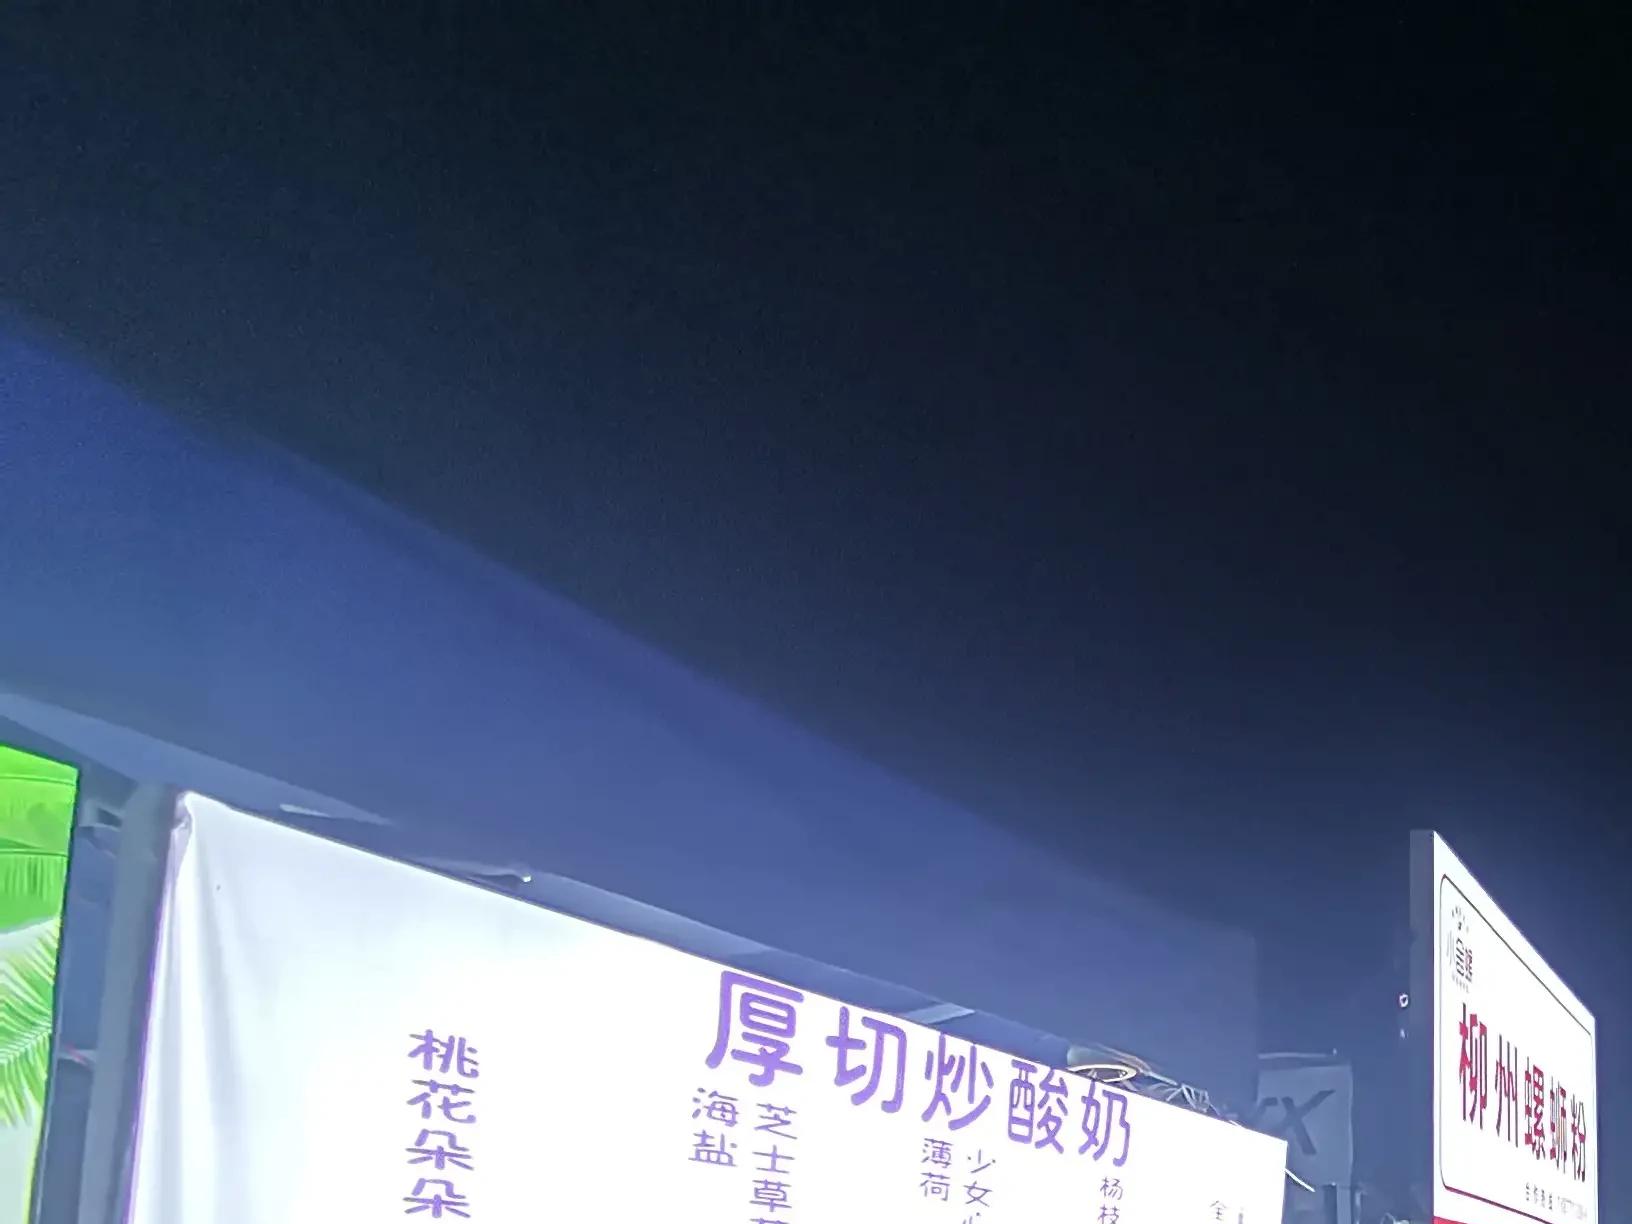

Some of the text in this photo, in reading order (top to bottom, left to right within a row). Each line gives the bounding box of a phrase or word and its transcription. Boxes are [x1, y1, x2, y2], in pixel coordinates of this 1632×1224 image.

[403, 1029, 480, 1220] 桃花朵朵
[688, 1087, 740, 1167] 海盐
[705, 970, 1132, 1167] 厚切炒酸奶
[1458, 1002, 1587, 1183] 柳州螺蛳粉
[919, 1136, 954, 1202] 薄荷
